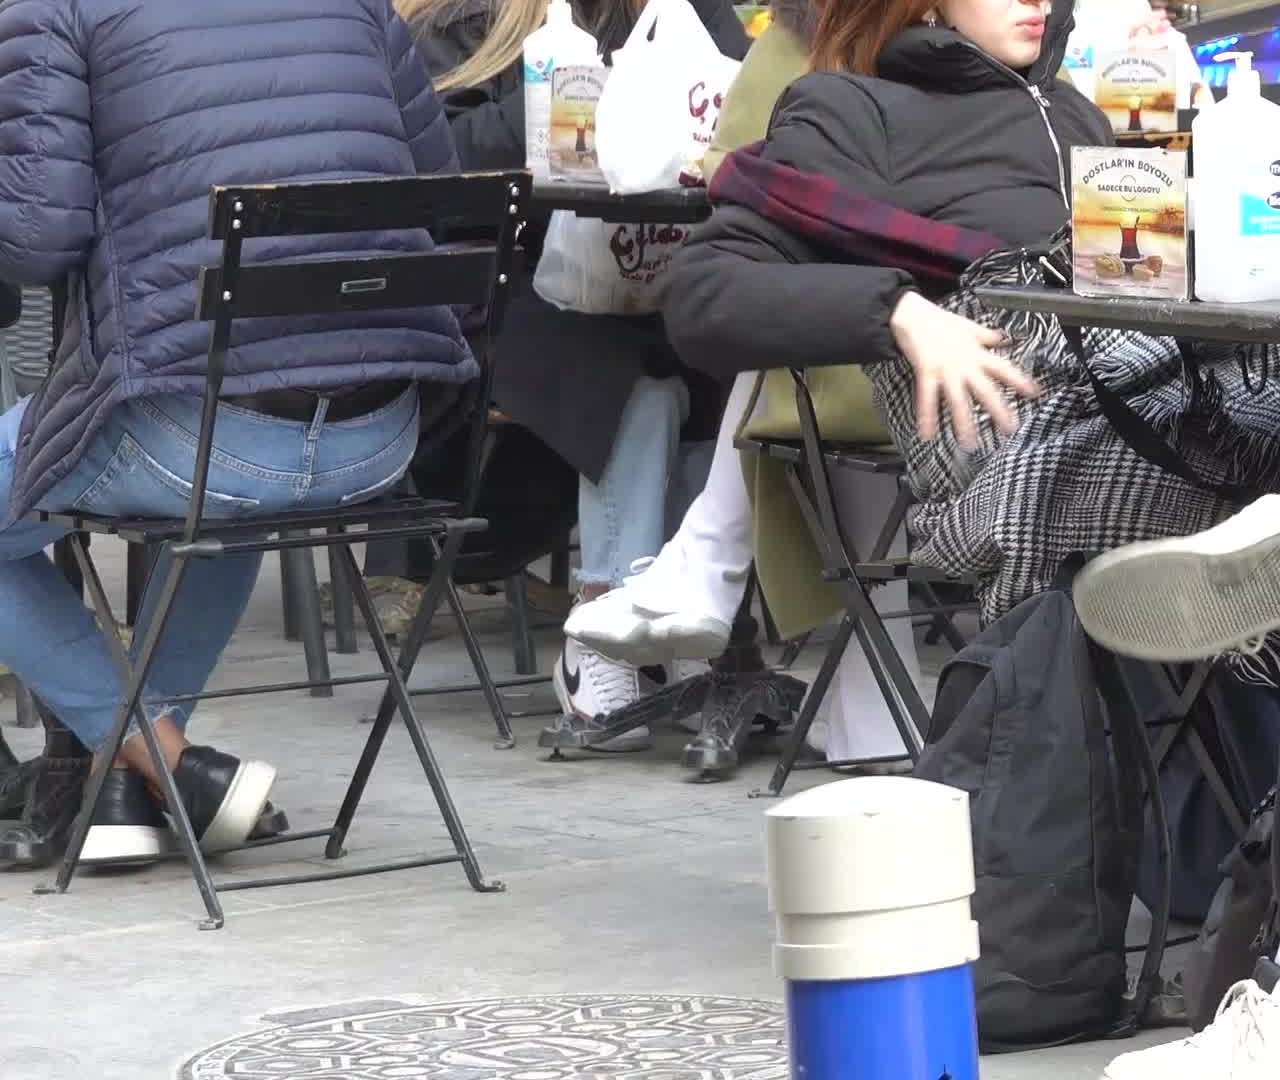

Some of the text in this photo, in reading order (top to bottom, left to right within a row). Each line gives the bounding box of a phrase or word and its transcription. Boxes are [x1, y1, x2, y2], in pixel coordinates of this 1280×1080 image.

[1082, 157, 1174, 188] DOSTLAR'IN BOYOZU
[1097, 184, 1161, 195] SADECE BU LOGOYU
